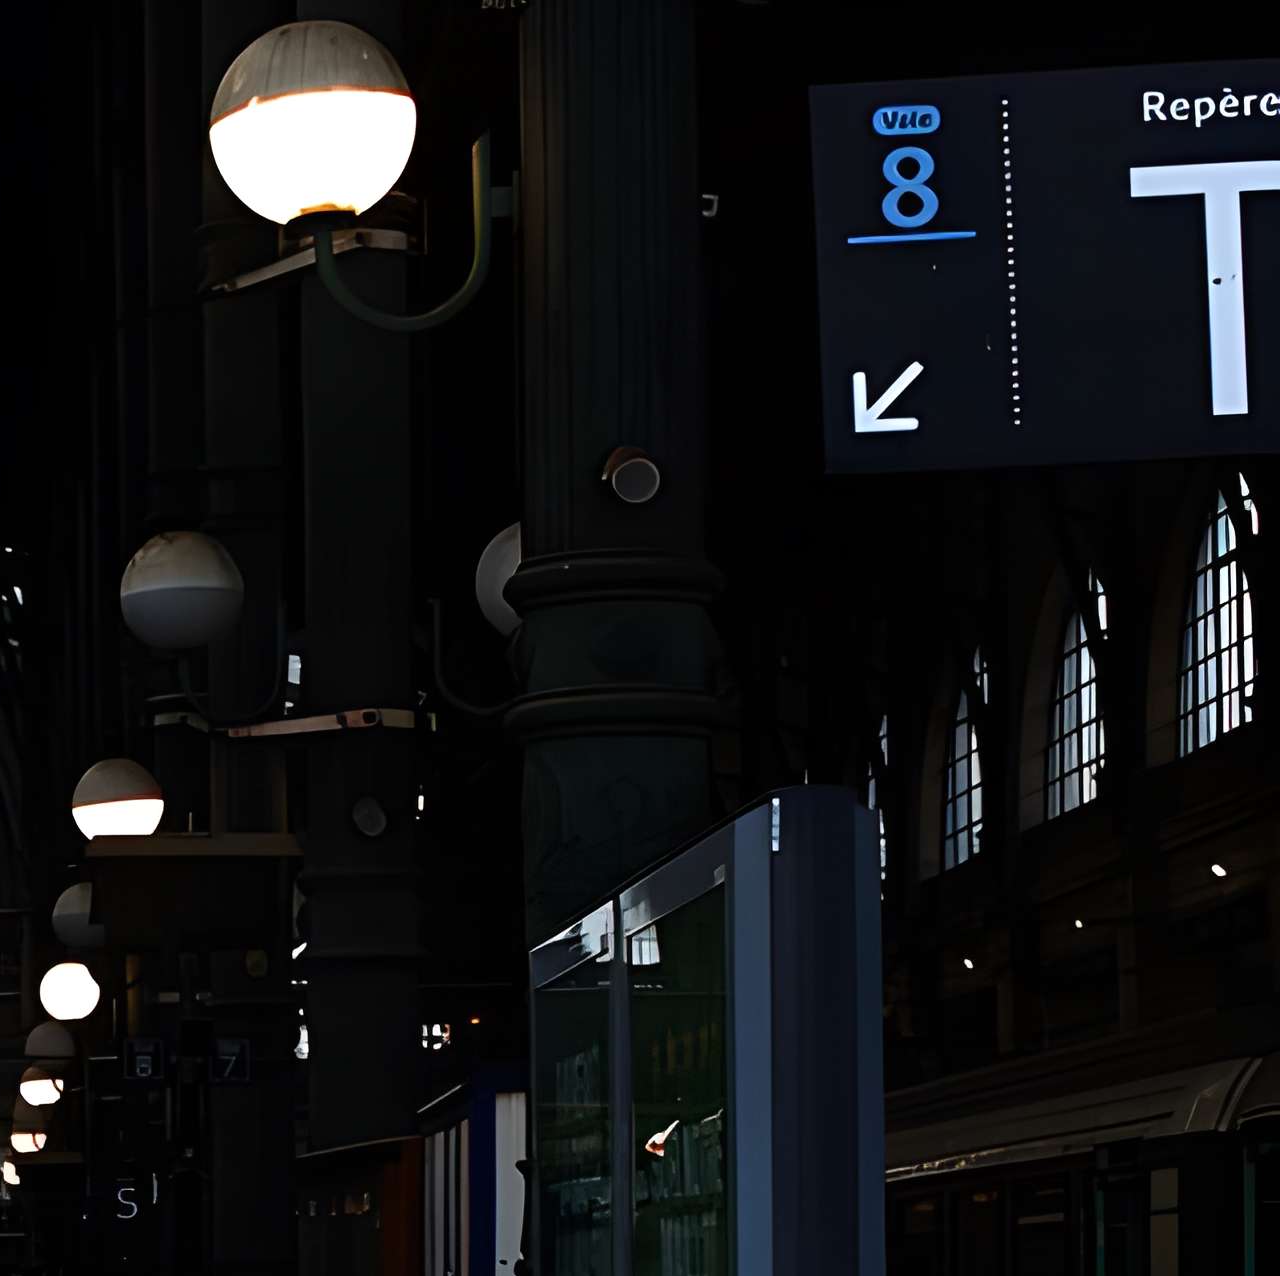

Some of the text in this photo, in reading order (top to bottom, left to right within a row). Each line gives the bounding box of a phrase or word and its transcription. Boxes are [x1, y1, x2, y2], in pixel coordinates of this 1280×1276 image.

[1142, 87, 1280, 128] Repère
[881, 145, 940, 229] 8
[1129, 159, 1280, 416] T
[116, 1186, 139, 1220] S
